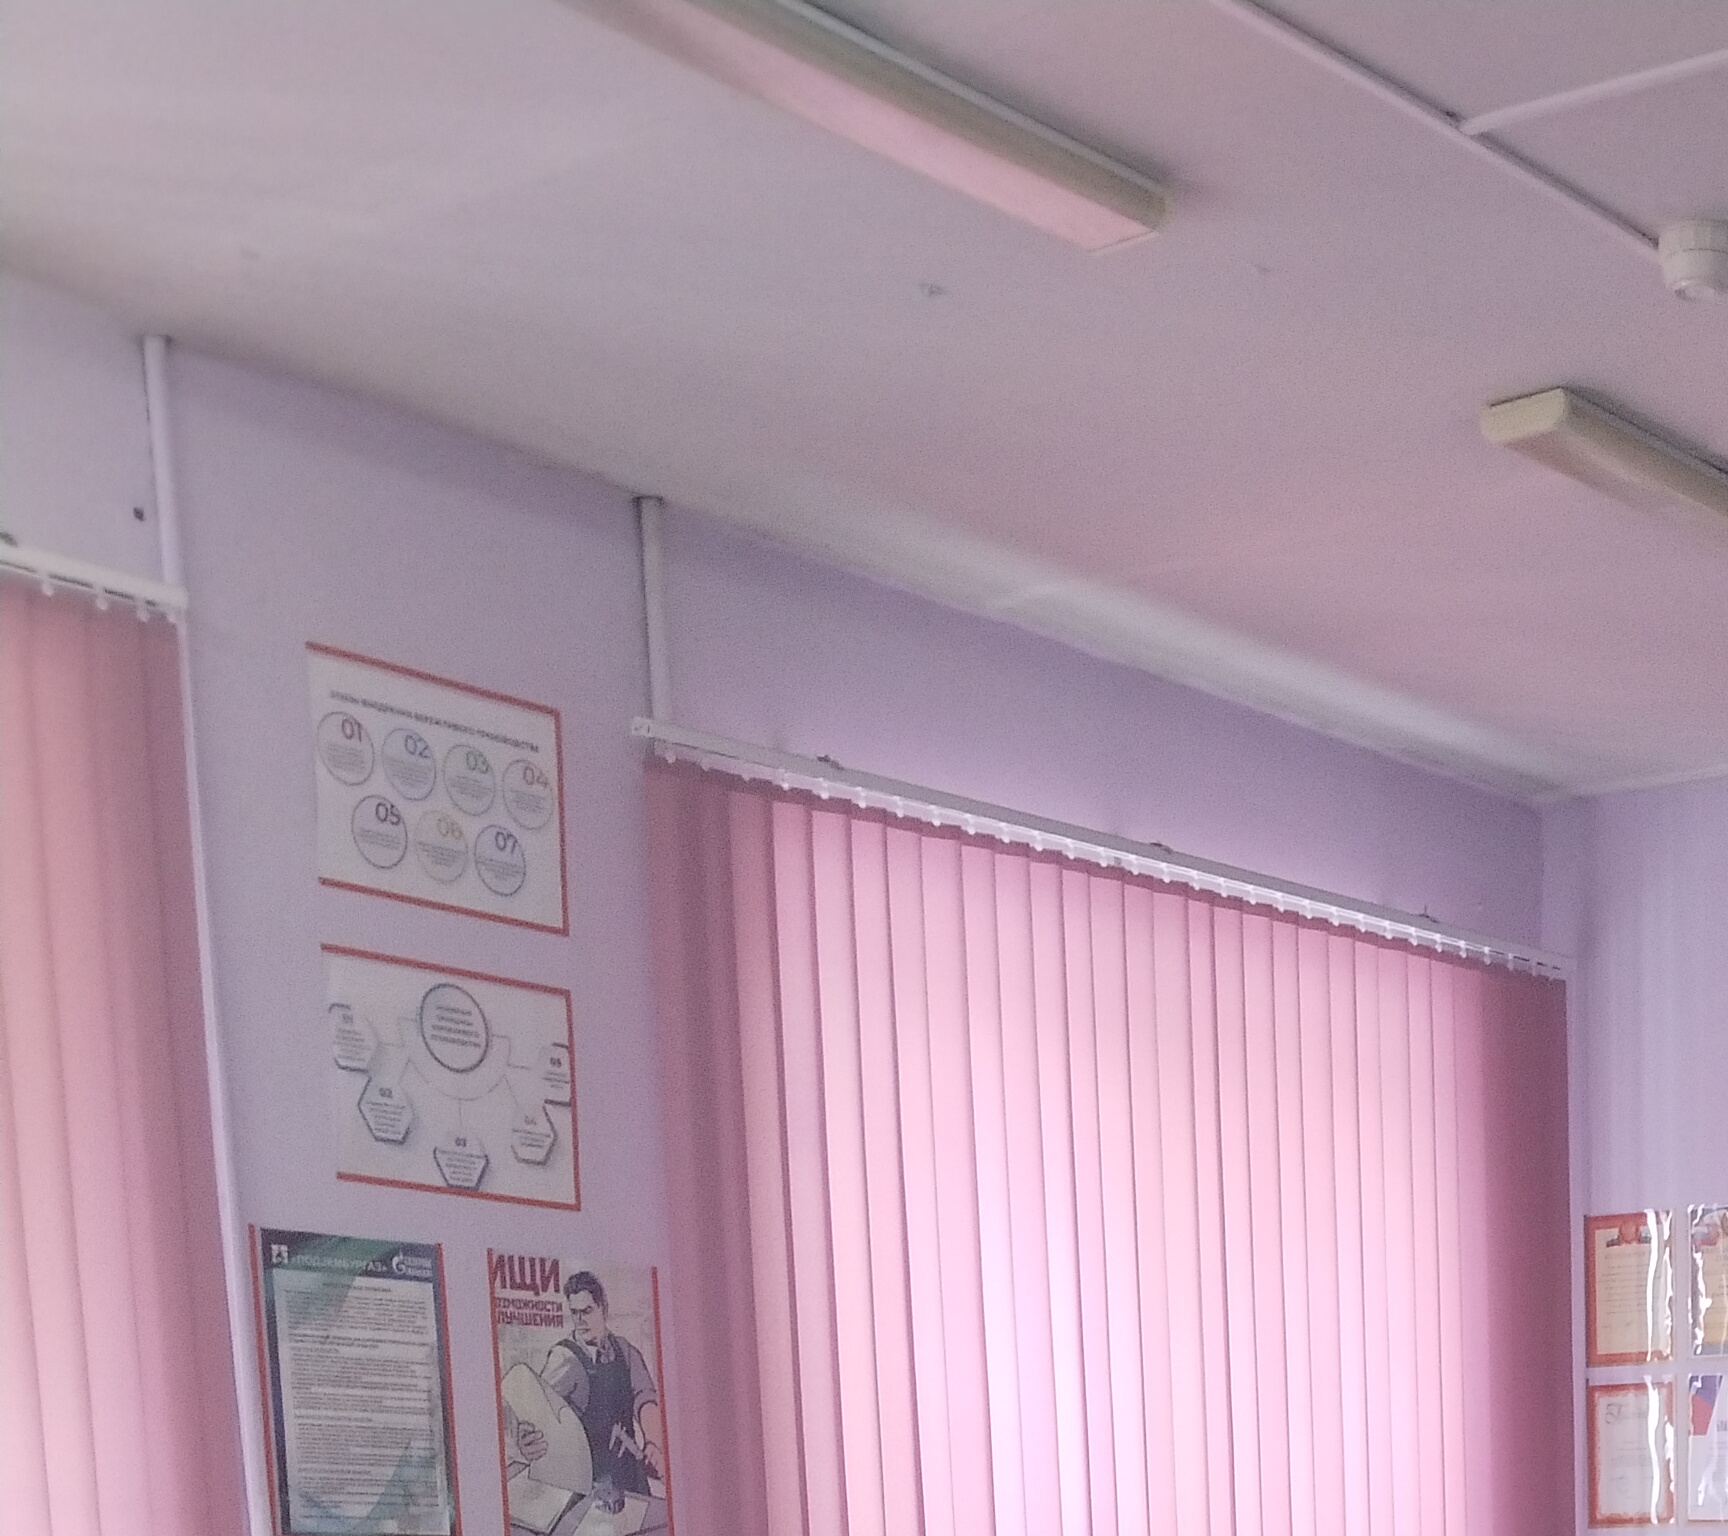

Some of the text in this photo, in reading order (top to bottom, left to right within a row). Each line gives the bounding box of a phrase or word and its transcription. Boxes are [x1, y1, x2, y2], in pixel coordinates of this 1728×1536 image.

[341, 717, 362, 742] 01
[405, 735, 430, 759] 02
[375, 802, 401, 826] 05
[497, 1311, 564, 1329] ЛУЧШЕНИЯ
